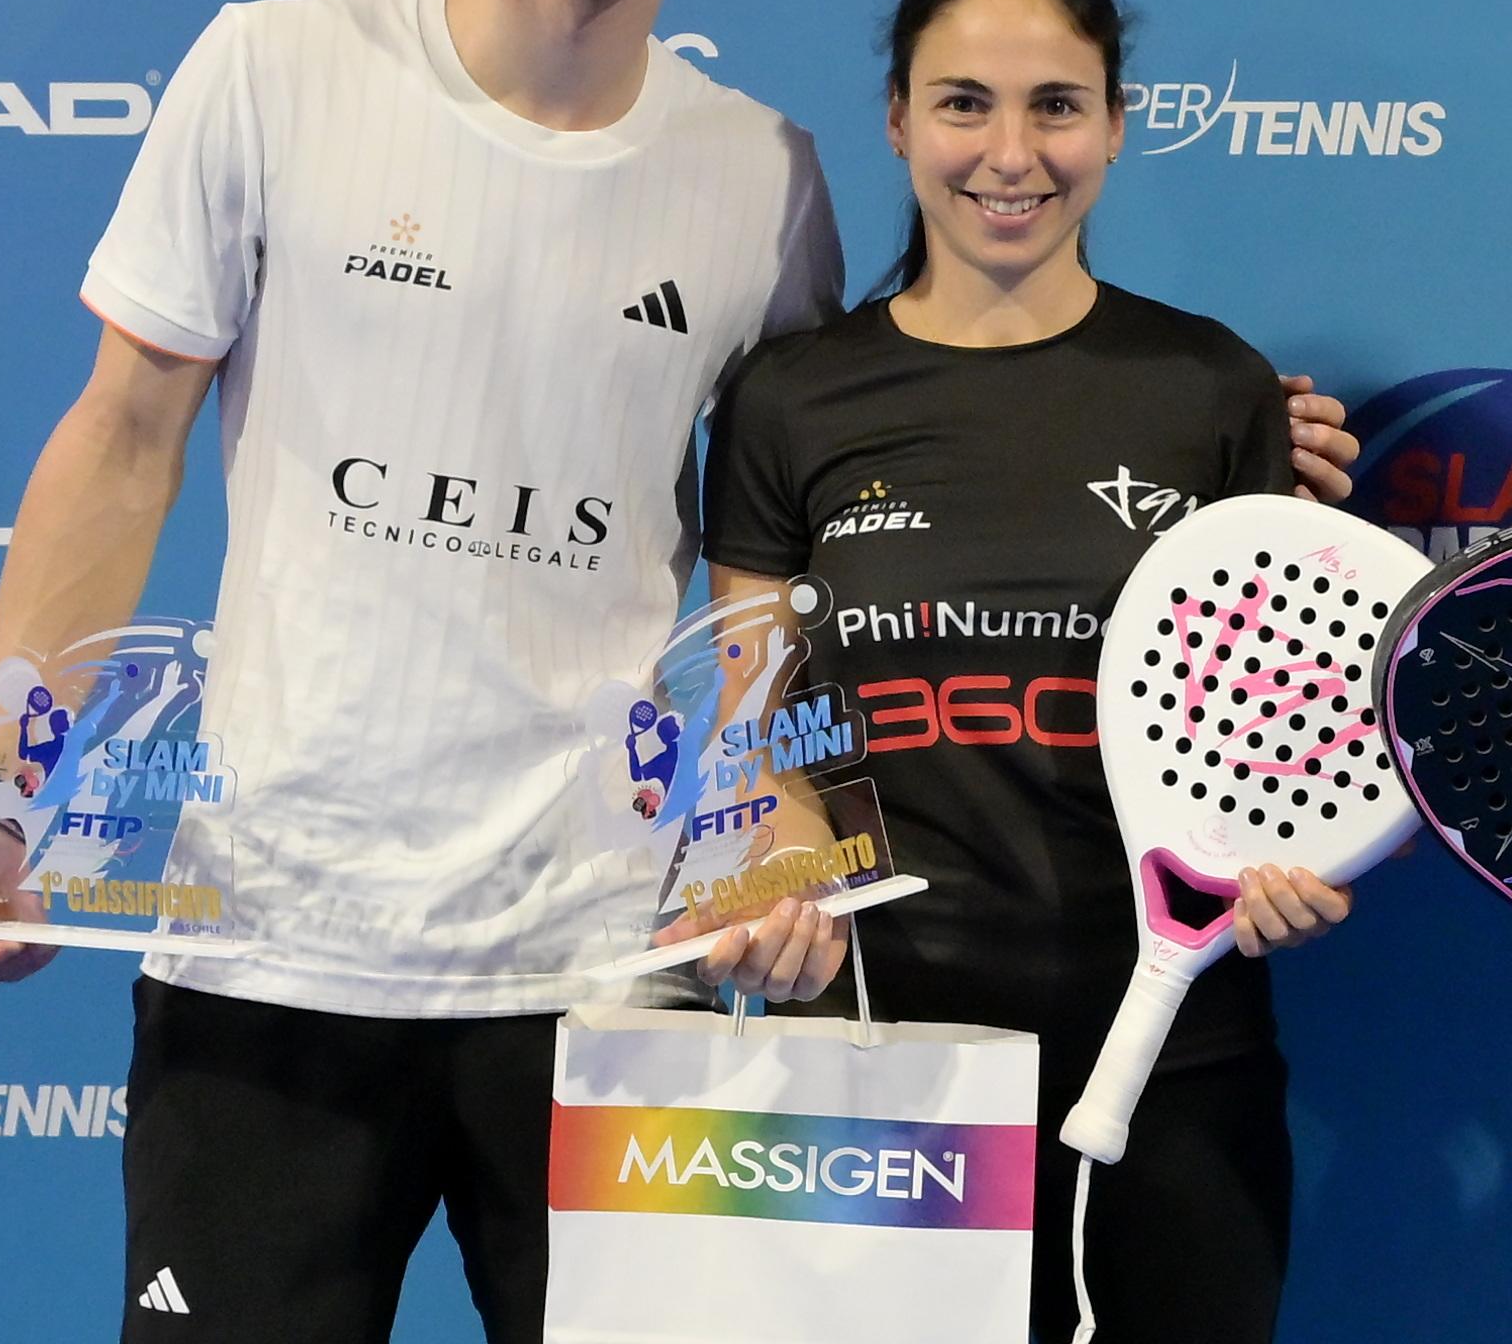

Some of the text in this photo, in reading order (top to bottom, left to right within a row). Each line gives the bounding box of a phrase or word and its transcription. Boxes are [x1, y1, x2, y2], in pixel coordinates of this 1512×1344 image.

[344, 254, 453, 292] PADEL
[369, 244, 434, 262] PREMIER
[331, 456, 615, 547] CEIS
[328, 510, 602, 573] TECNICO LEGALE
[821, 510, 932, 544] PADEL
[836, 601, 1108, 648] Phi!Numb
[720, 694, 833, 758] SLAM
[103, 738, 210, 773] SLAM
[772, 721, 854, 775] MINI
[143, 770, 225, 804] MINI
[60, 812, 144, 839] FITP
[691, 794, 778, 843] FITP
